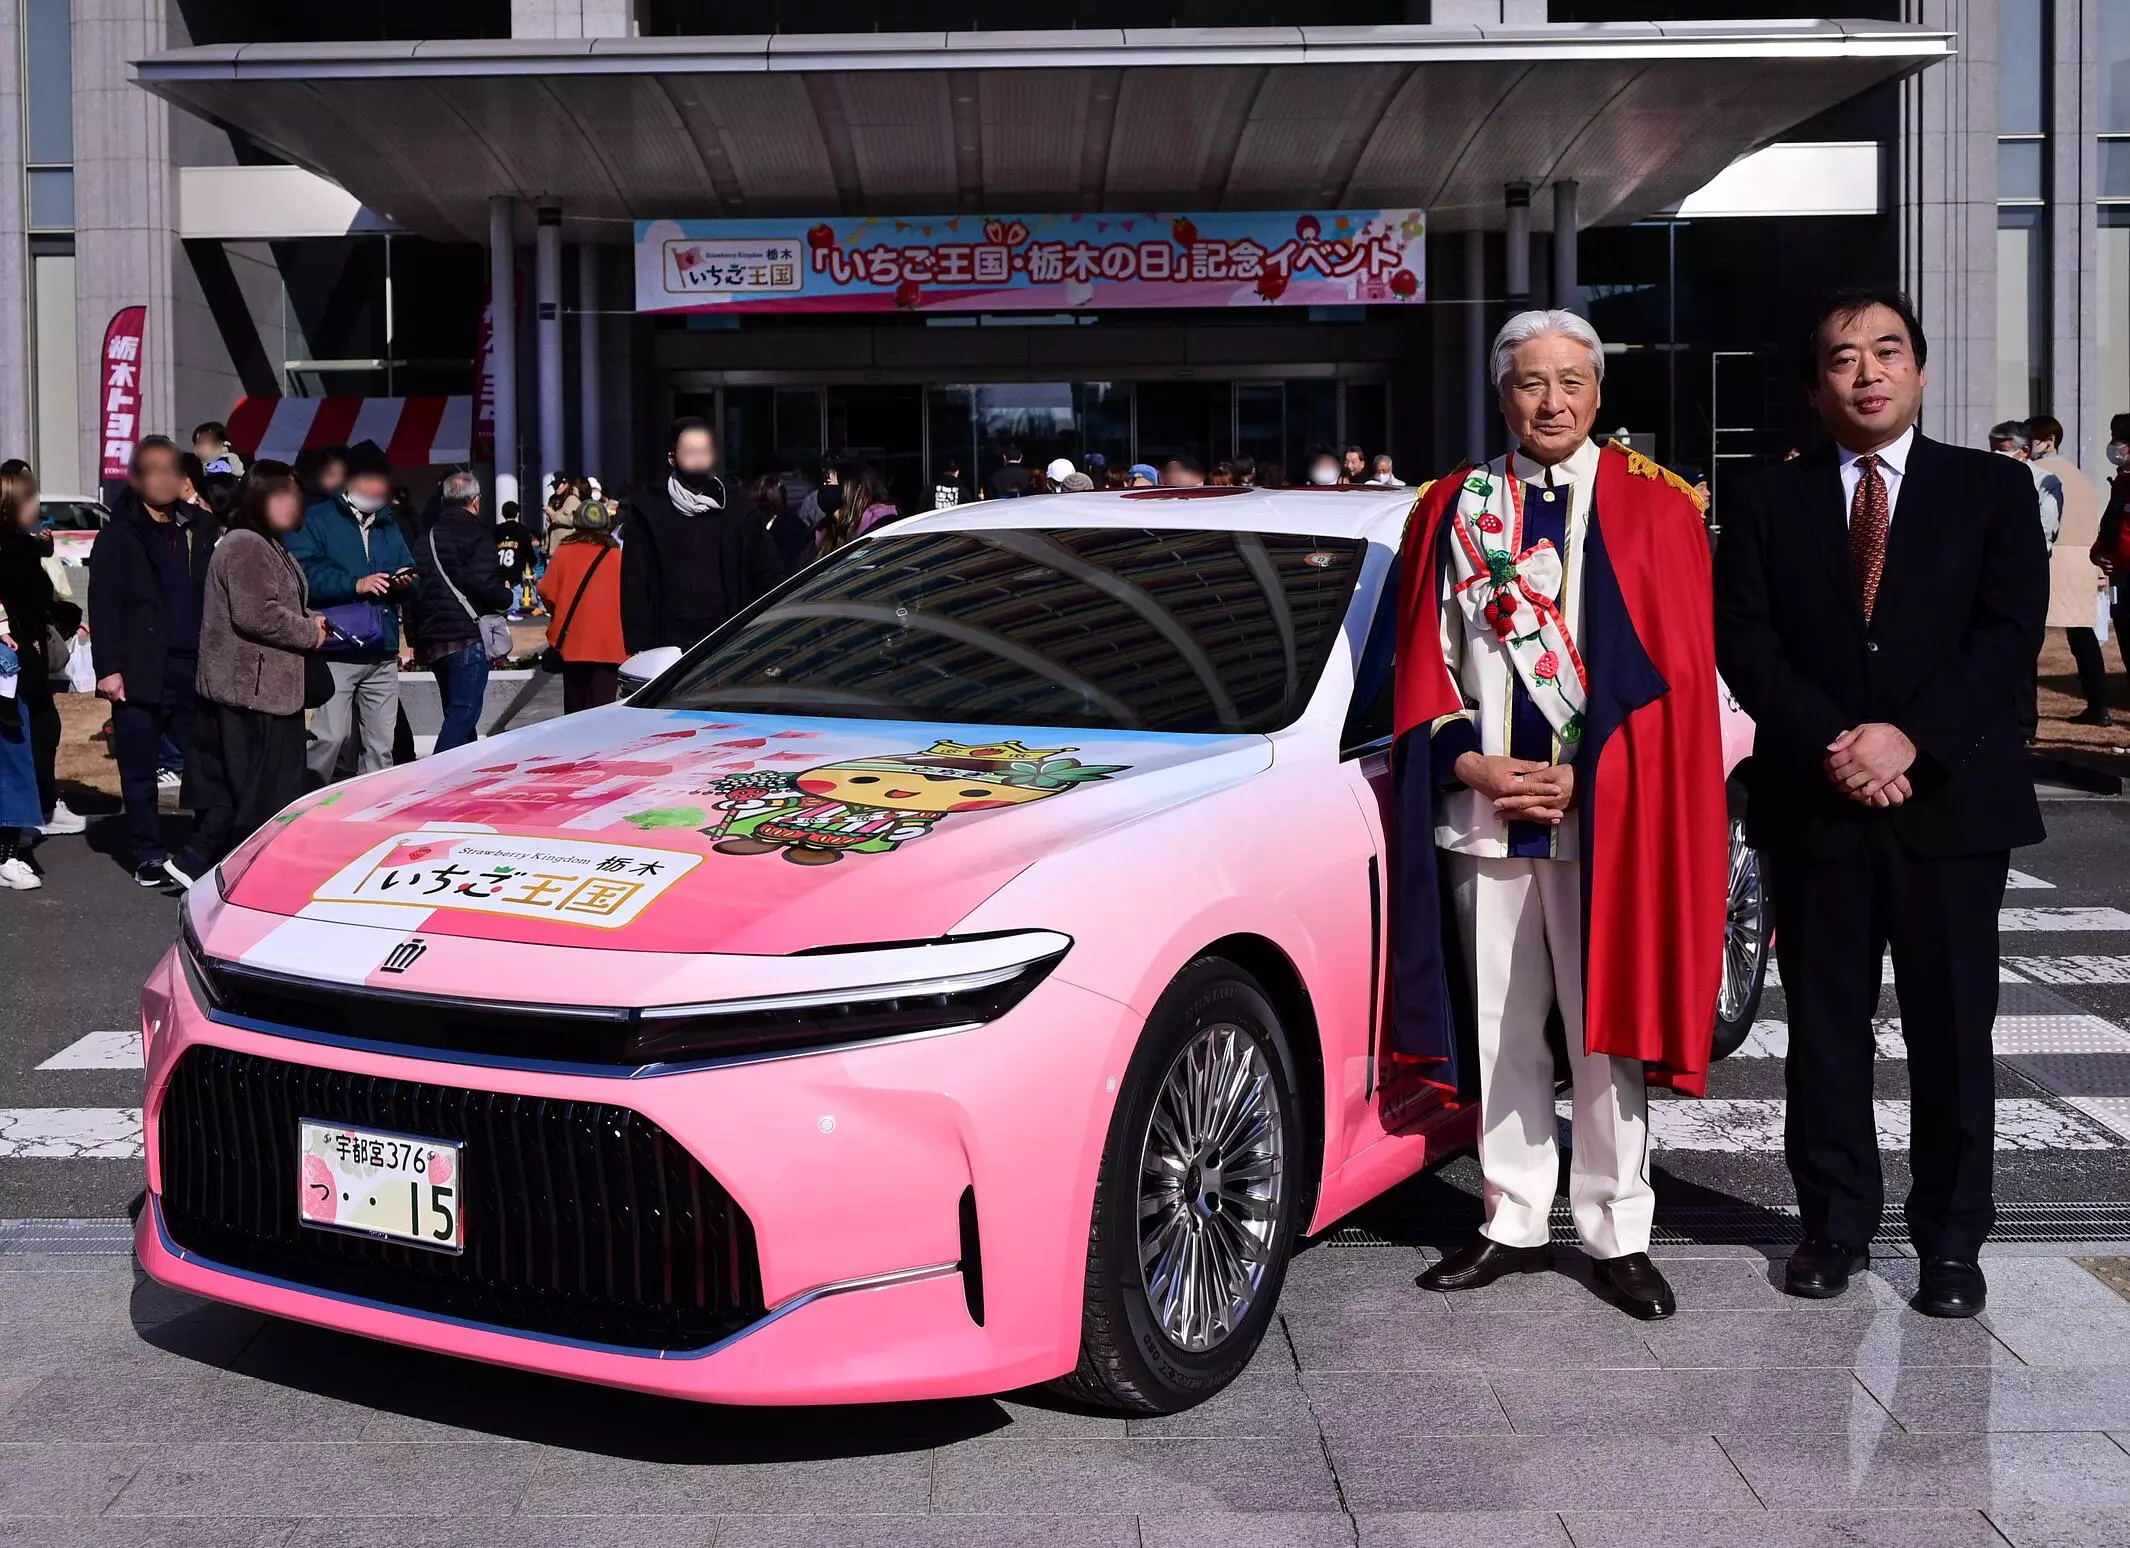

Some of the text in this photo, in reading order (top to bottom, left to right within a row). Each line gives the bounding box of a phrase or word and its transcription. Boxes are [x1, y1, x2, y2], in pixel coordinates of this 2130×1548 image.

[766, 248, 793, 261] 栃木
[813, 239, 1401, 283] 「いちご王国・栃木の日」記念イベント
[689, 264, 794, 287] いちご王国
[104, 335, 140, 466] 栃木トヨタ
[497, 548, 515, 567] 18
[458, 847, 591, 865] Strawberry Kingdom
[596, 855, 665, 876] 栃木
[380, 864, 645, 916] いちご王国
